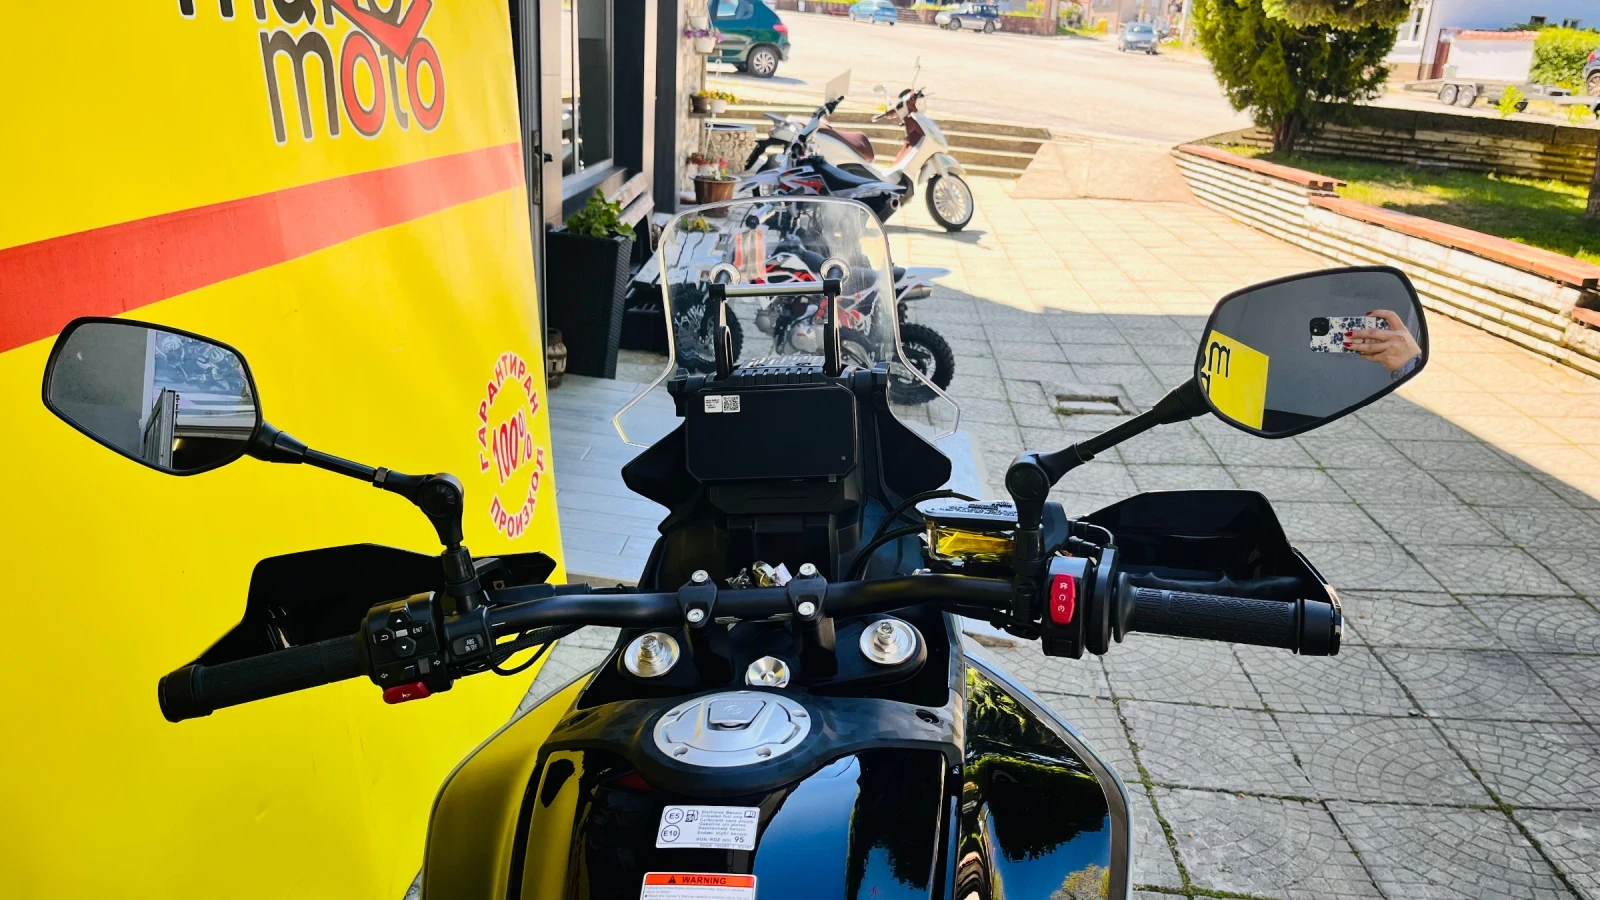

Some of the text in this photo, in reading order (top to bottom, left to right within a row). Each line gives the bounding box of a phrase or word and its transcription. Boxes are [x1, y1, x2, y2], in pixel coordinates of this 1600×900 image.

[478, 353, 539, 471] ГАРАНТИРАН
[492, 406, 532, 484] 100%
[490, 448, 544, 538] ПРОИЗХОД
[682, 876, 727, 885] WARNING
